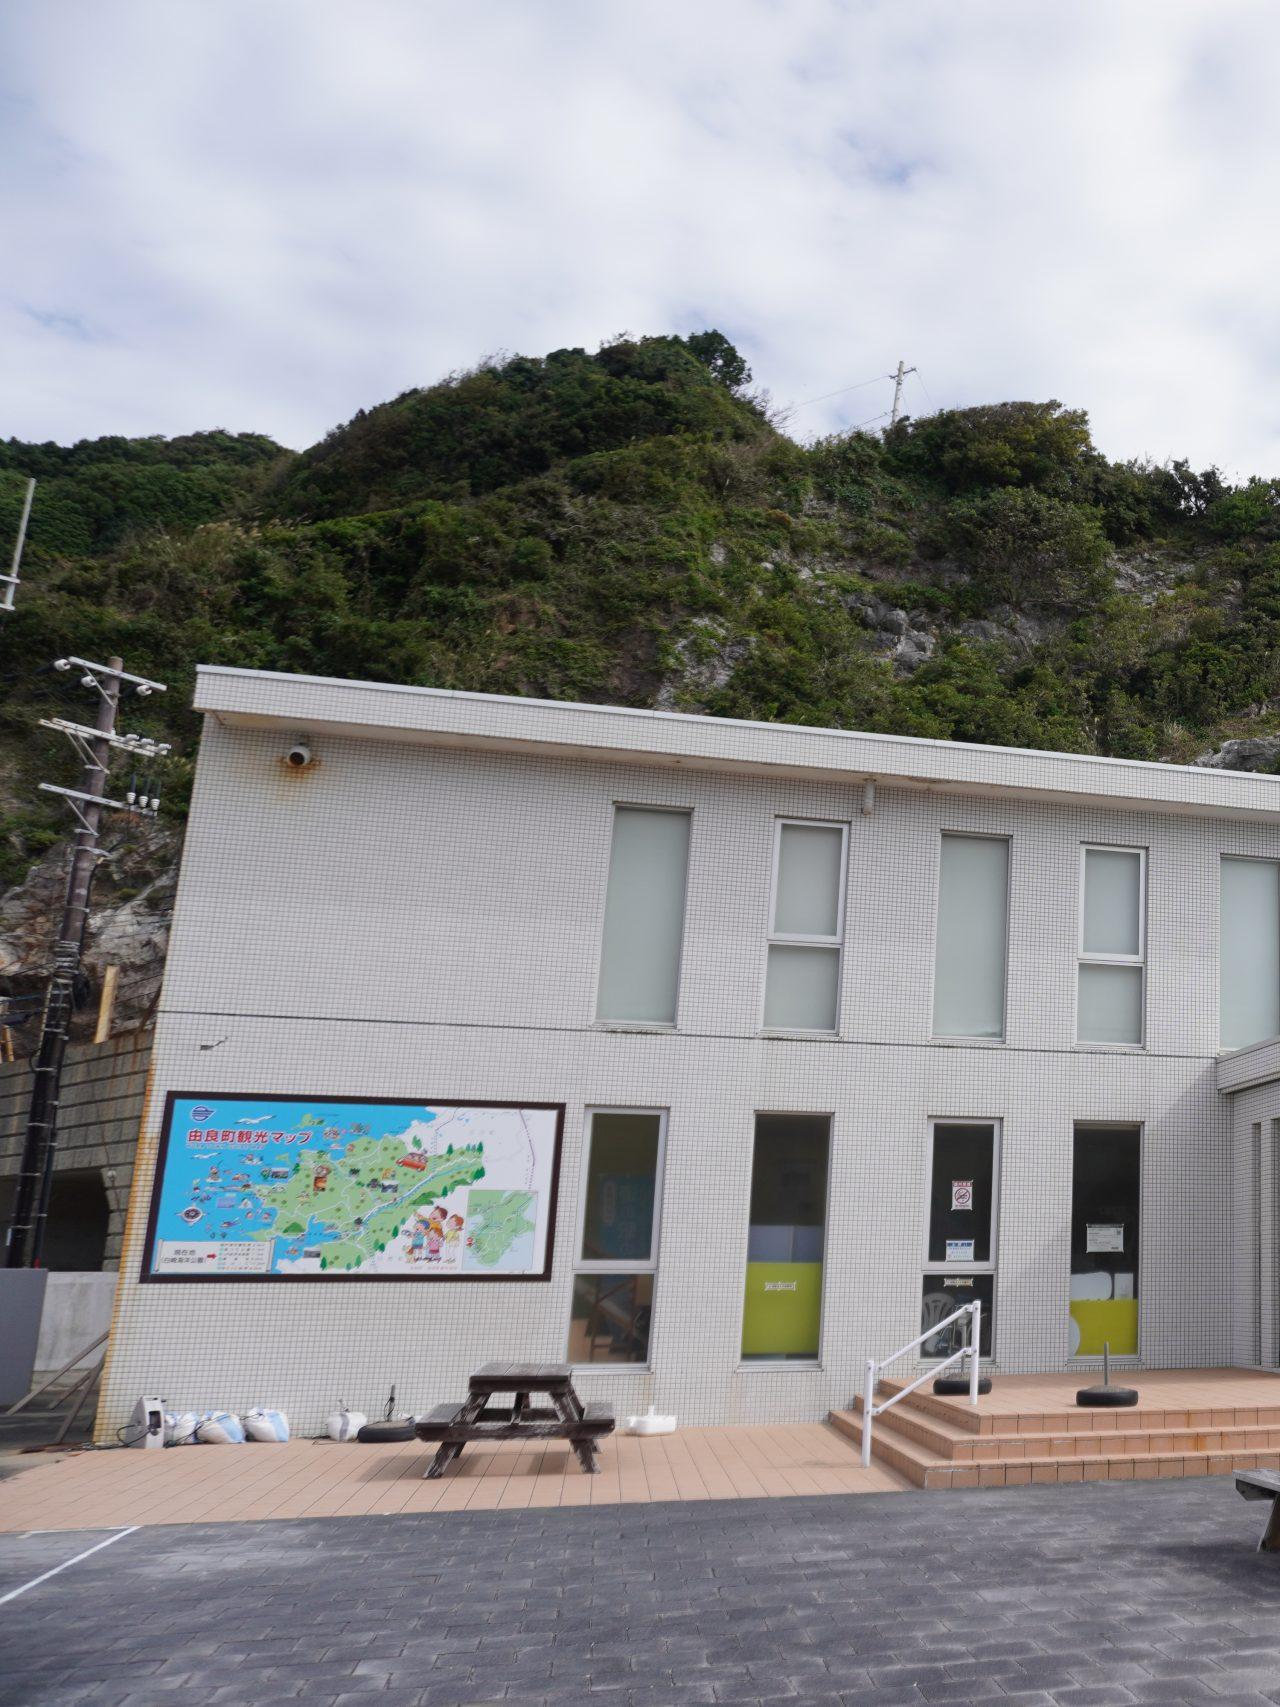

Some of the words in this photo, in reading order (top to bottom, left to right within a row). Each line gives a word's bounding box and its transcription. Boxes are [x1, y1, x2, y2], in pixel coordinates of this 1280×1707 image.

[188, 1128, 313, 1145] 由良町観光マップ
